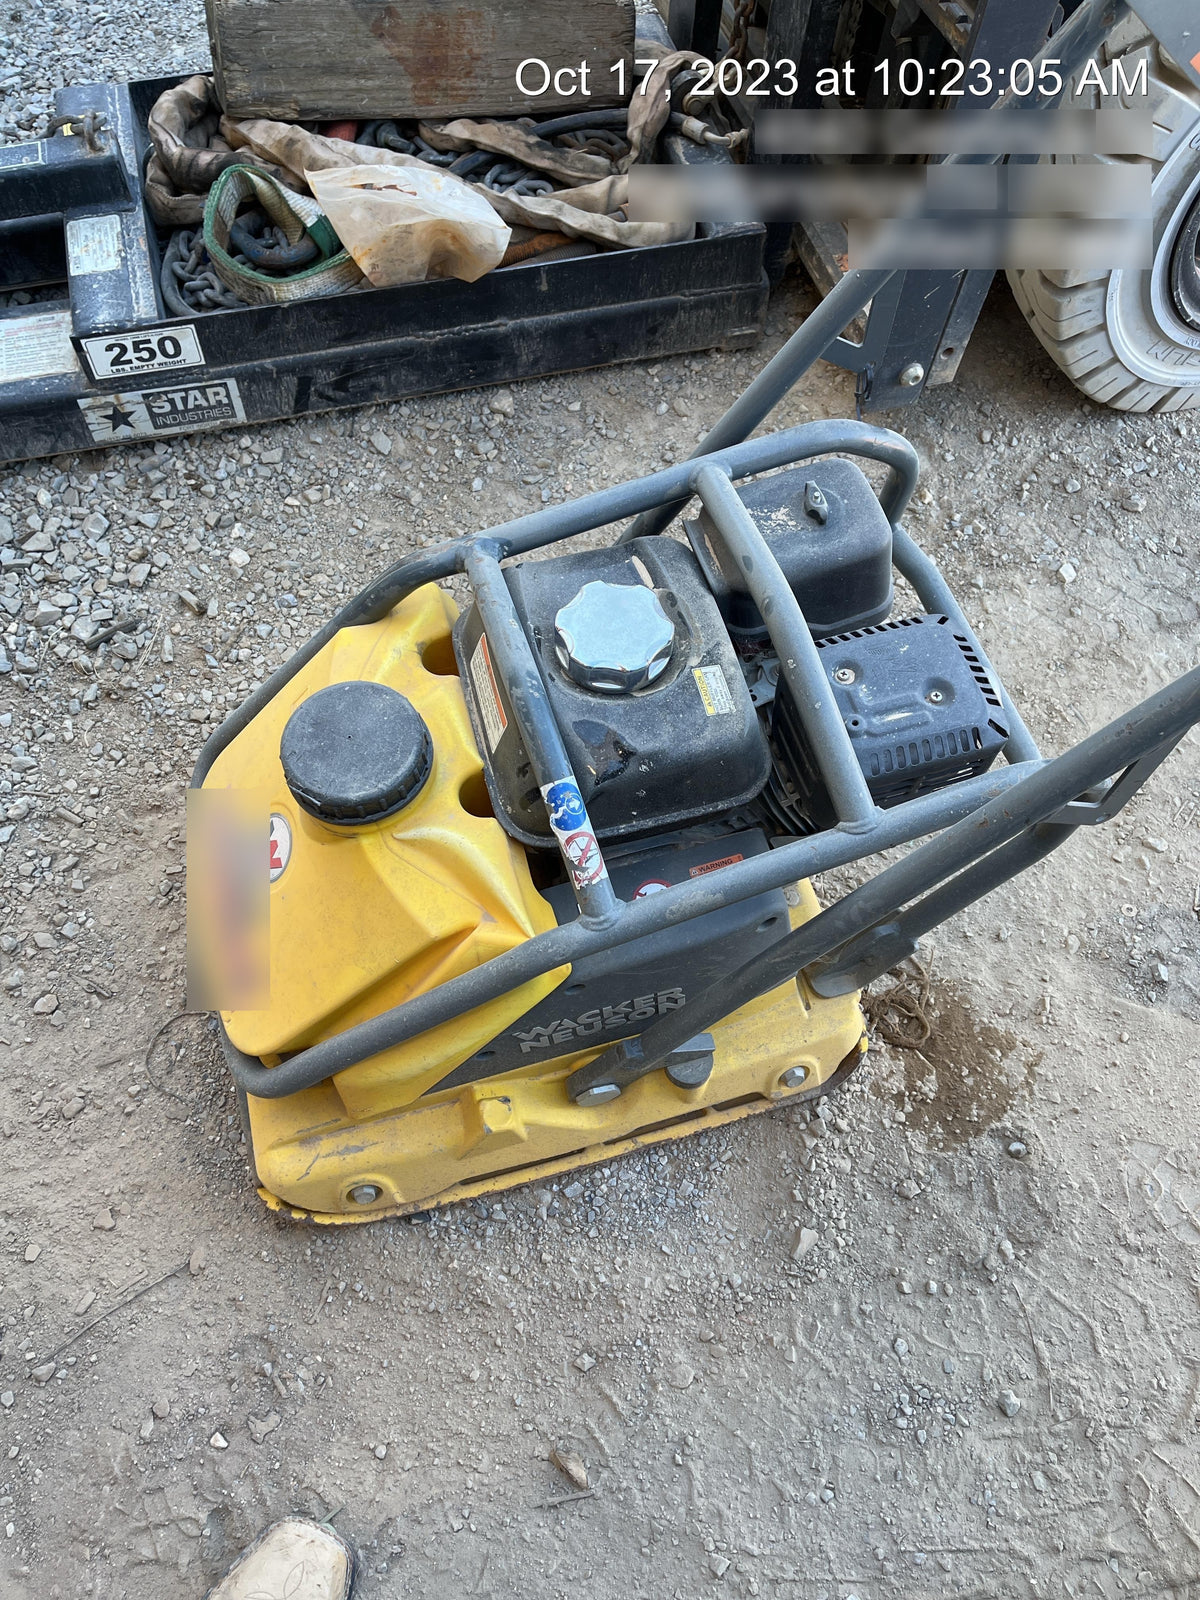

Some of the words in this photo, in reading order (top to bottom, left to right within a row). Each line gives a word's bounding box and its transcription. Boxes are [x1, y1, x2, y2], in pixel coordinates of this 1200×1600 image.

[104, 335, 182, 367] 250
[130, 363, 155, 371] EMPTY
[157, 358, 187, 367] WEIGHT
[149, 386, 229, 414] STAR
[155, 406, 232, 426] INDUSTRIES
[698, 858, 733, 873] WARNING
[512, 987, 685, 1041] WACKER
[519, 993, 686, 1053] NEUSON
